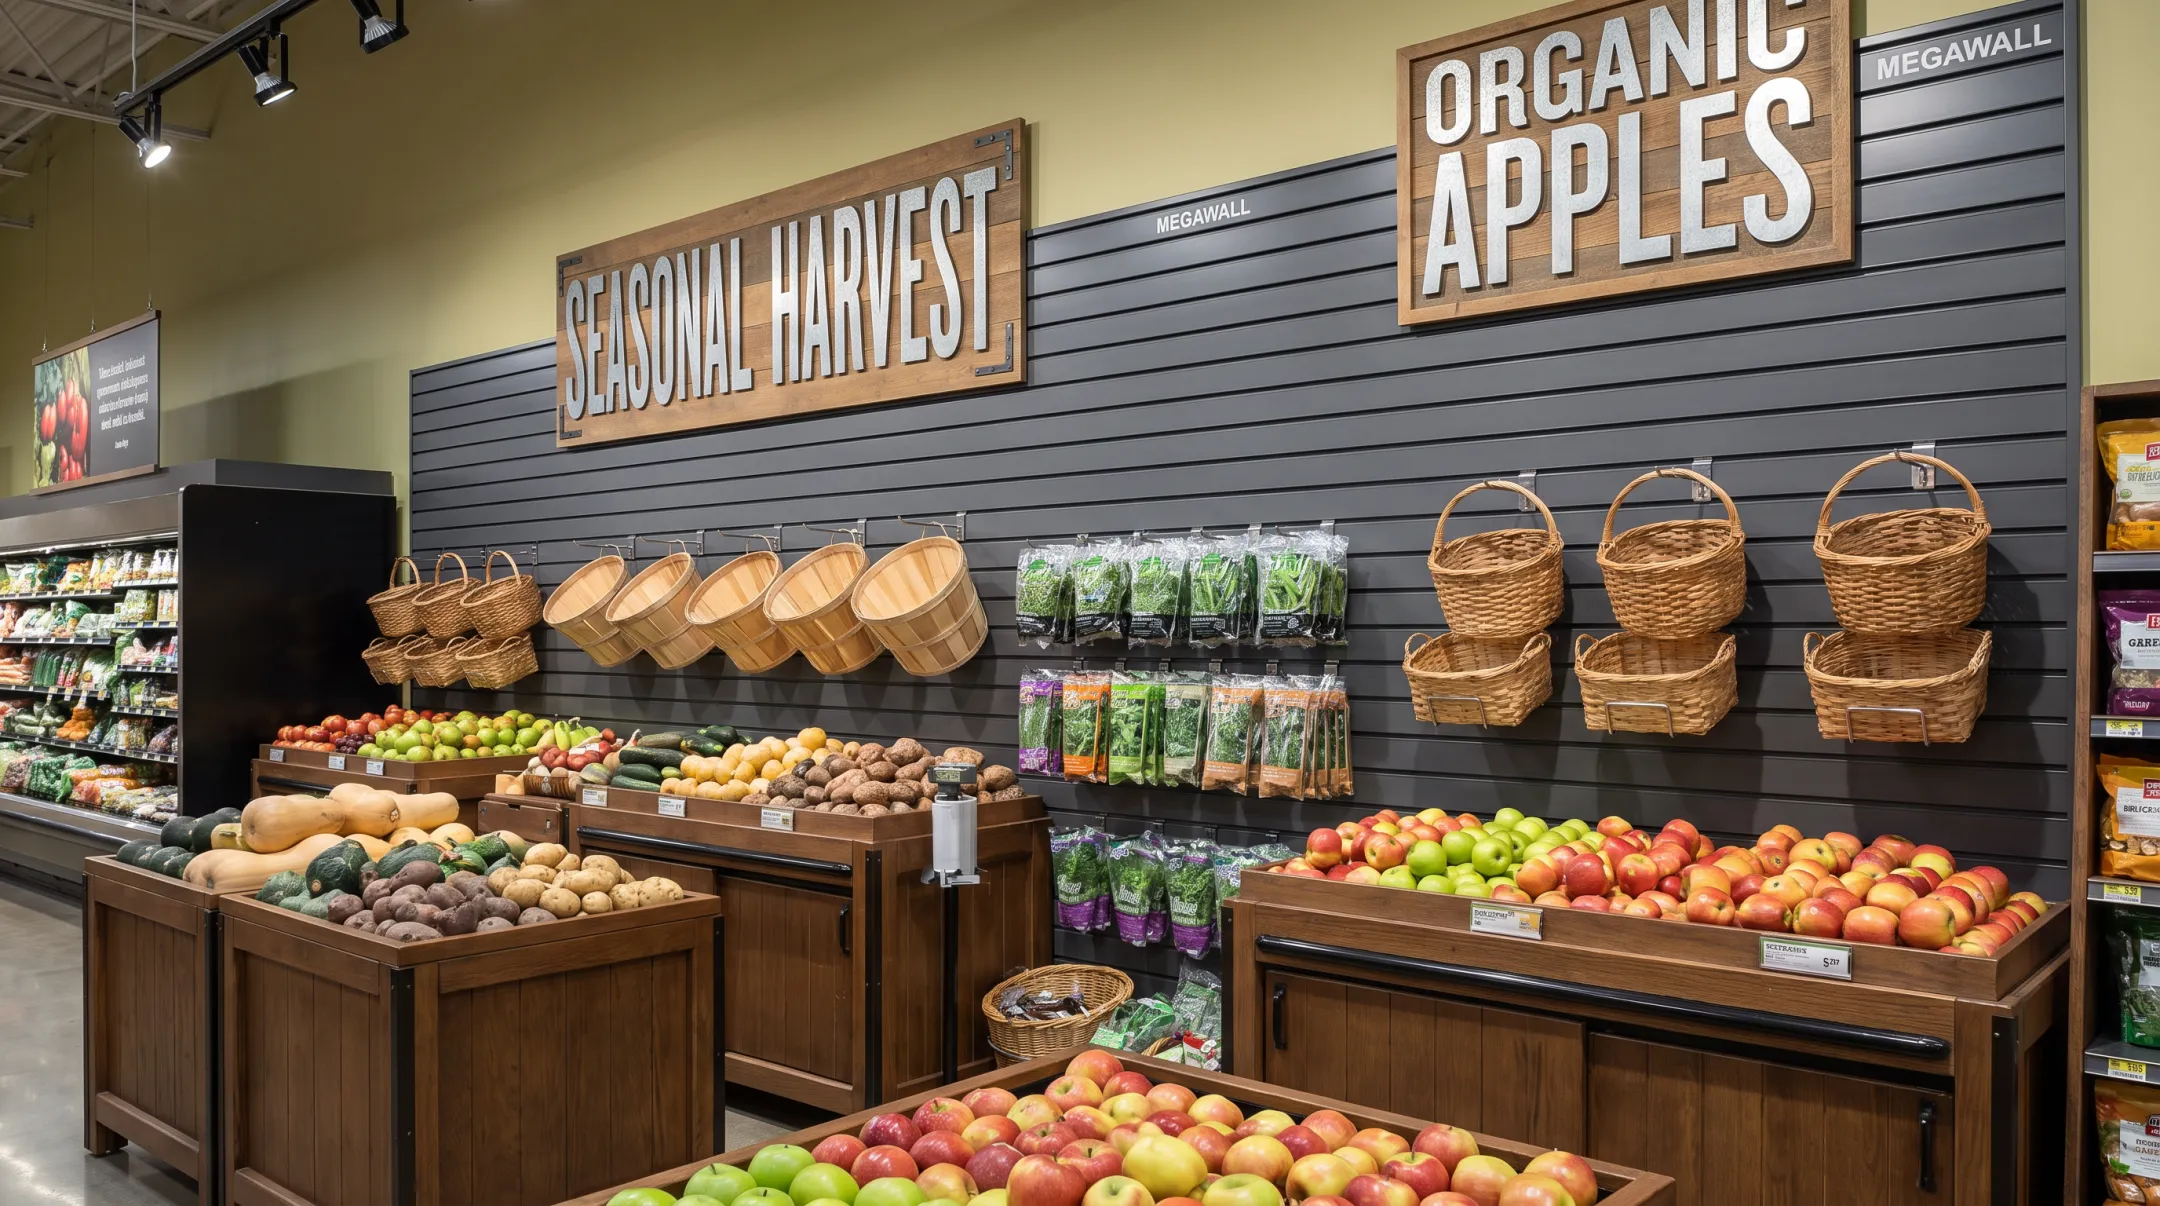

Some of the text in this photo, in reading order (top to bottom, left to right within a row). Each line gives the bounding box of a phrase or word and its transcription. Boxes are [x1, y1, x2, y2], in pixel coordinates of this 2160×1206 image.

[1425, 0, 1806, 146] ORGANIC
[1876, 23, 2052, 81] MEGAWALL
[1156, 198, 1251, 234] MEGAWALL
[1422, 76, 1814, 296] APPLES
[565, 166, 998, 420] SEASONAL HARVEST
